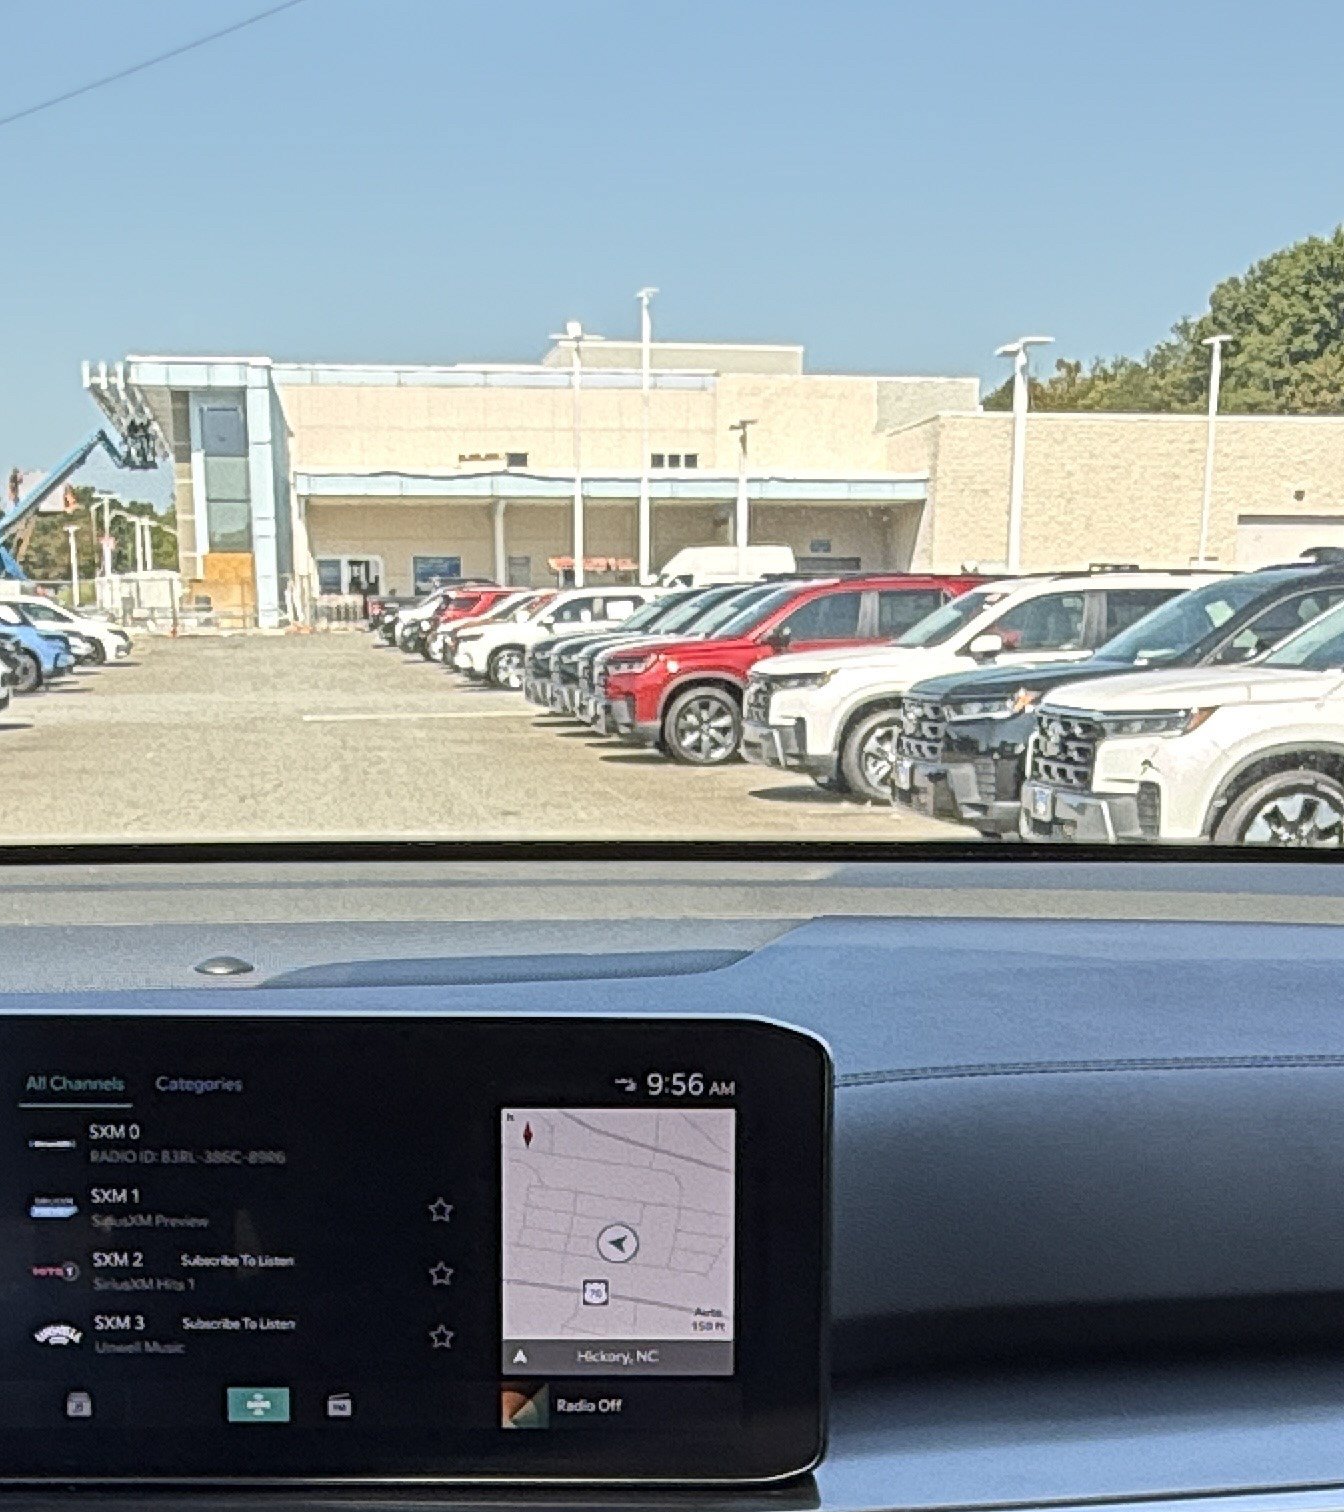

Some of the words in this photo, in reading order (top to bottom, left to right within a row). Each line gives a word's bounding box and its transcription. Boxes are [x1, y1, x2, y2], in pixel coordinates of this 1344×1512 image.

[26, 1075, 47, 1092] All
[49, 1075, 125, 1092] Channels
[155, 1075, 244, 1096] Categories
[646, 1073, 705, 1097] 9:56
[708, 1081, 736, 1097] AM
[89, 1124, 125, 1141] SXM
[128, 1124, 141, 1141] 0
[90, 1188, 129, 1205] SXM
[131, 1188, 141, 1205] 1
[90, 1213, 154, 1229] SiriusXM
[156, 1213, 210, 1229] Preview
[92, 1252, 130, 1269] SXM
[132, 1252, 144, 1269] 2
[180, 1253, 240, 1269] Subscribe
[242, 1253, 256, 1269] To
[258, 1253, 296, 1269] Listen
[93, 1314, 130, 1332] SXM
[133, 1314, 146, 1332] 3
[181, 1317, 242, 1332] Subscribe
[243, 1317, 258, 1332] To
[259, 1317, 297, 1332] Listen
[144, 1340, 186, 1355] Music
[576, 1348, 634, 1367] Hickory,
[636, 1349, 660, 1365] NC
[556, 1398, 595, 1414] Radio
[598, 1398, 623, 1414] Off
